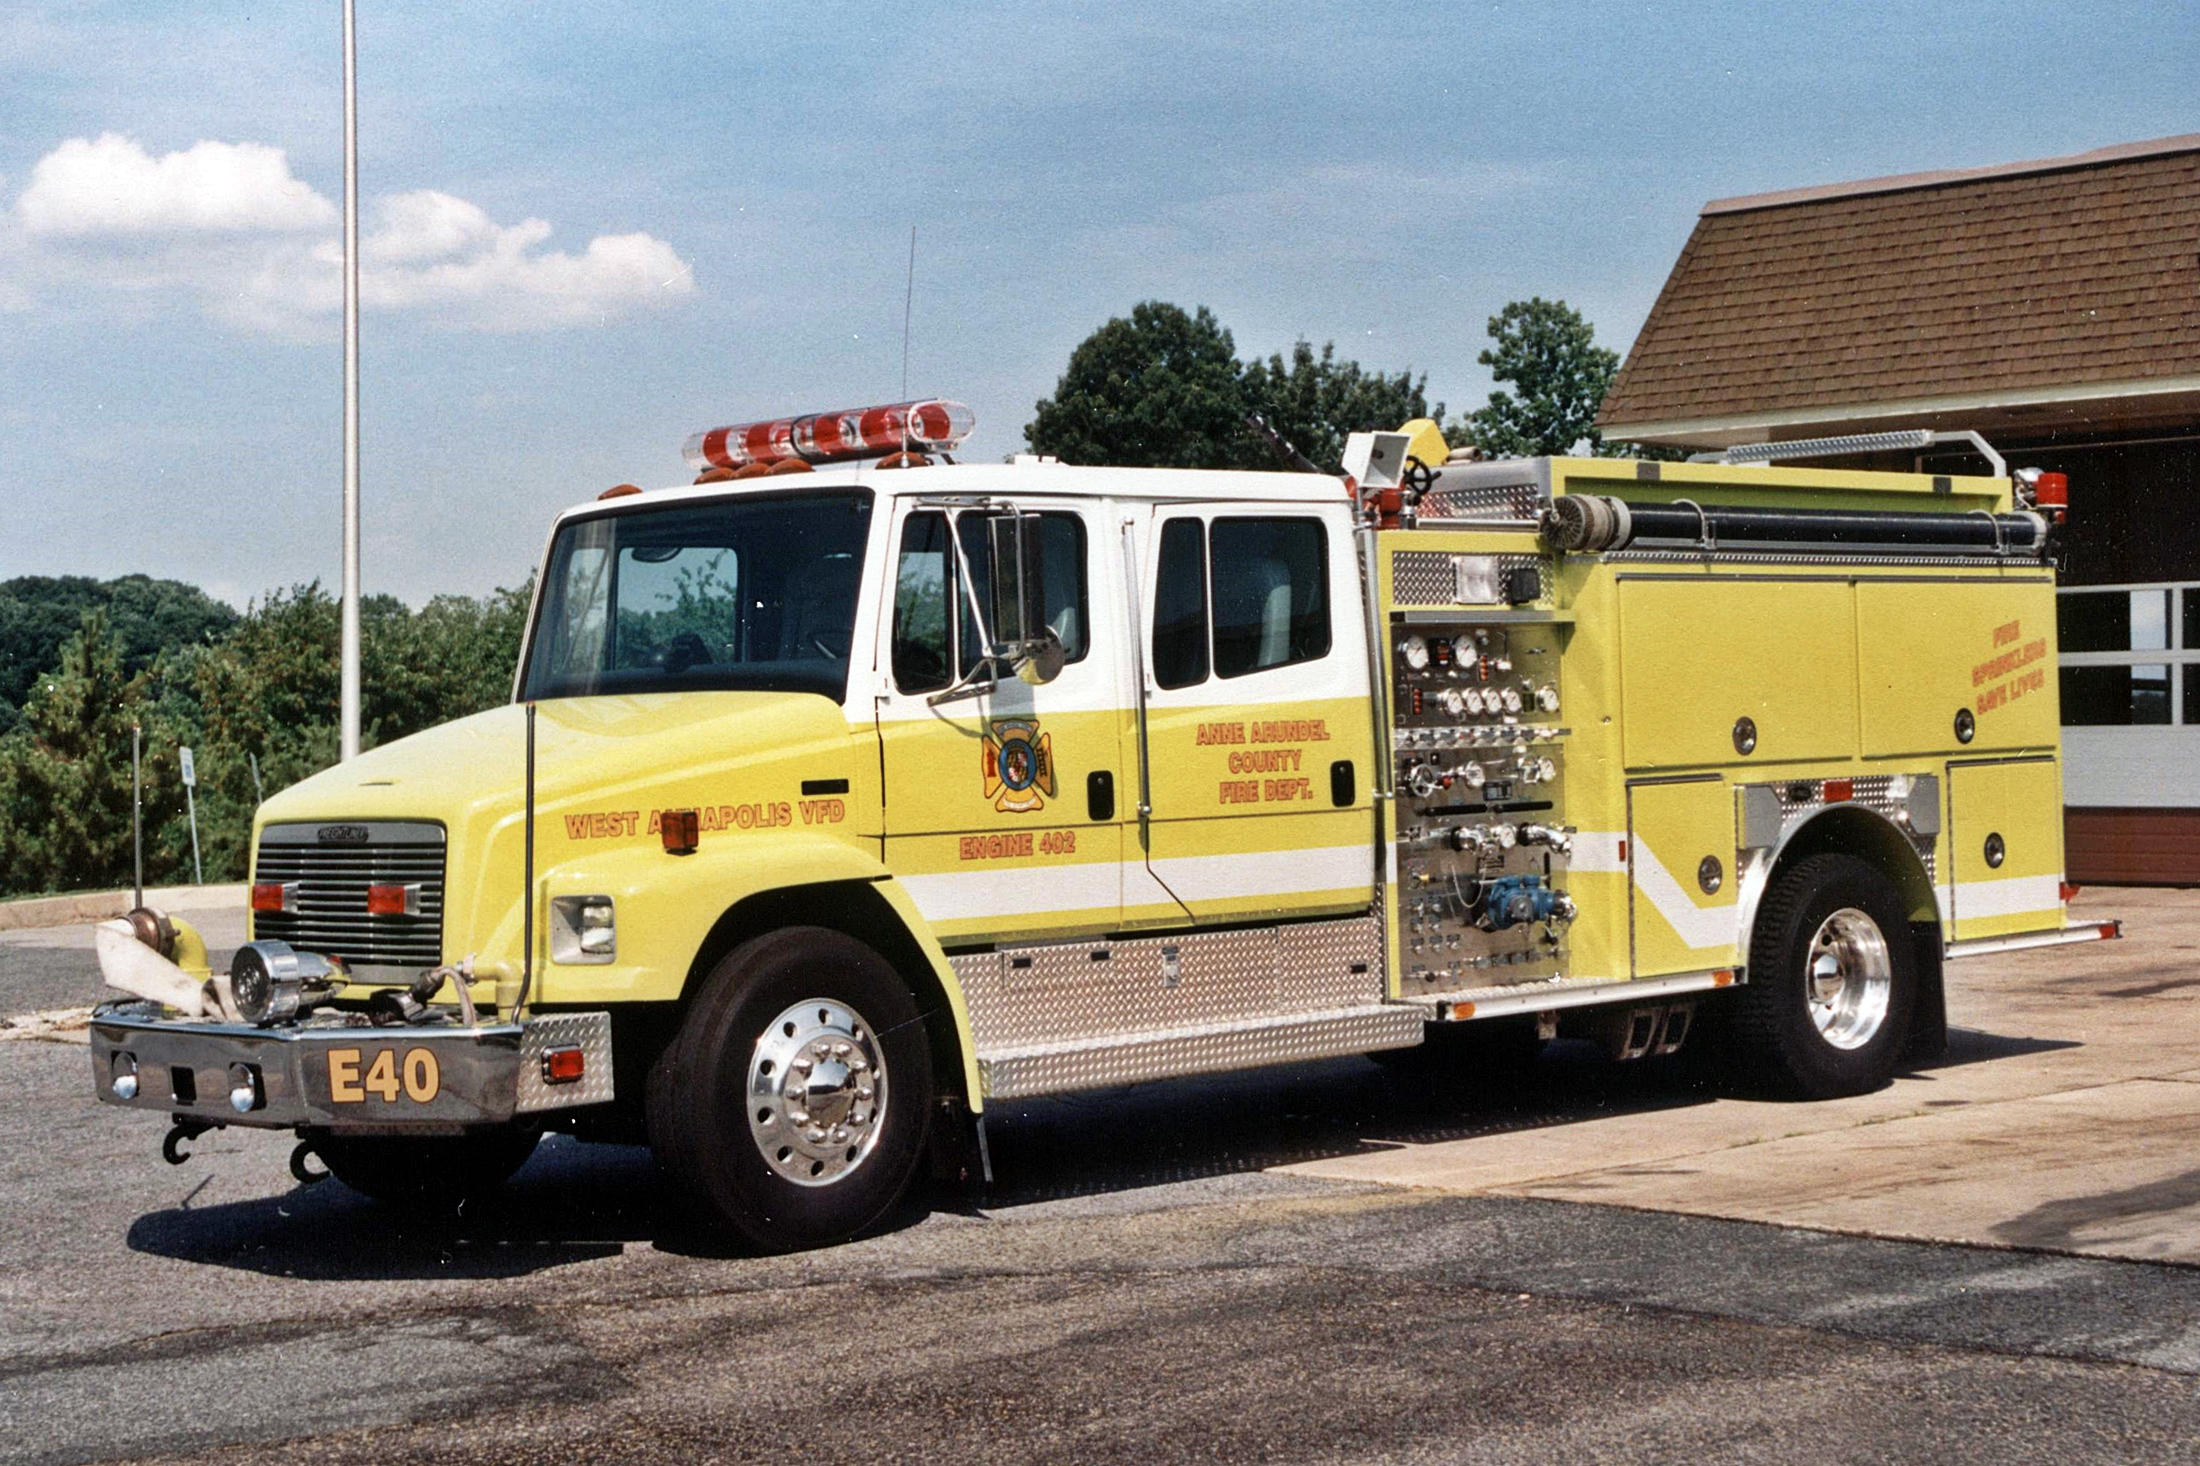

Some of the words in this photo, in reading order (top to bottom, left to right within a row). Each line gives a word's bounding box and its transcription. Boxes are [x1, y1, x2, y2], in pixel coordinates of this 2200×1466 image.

[1196, 723, 1245, 745] ANNE
[1251, 720, 1330, 743] ARUNDEL
[1229, 749, 1302, 773] COUNTY
[1219, 781, 1259, 804] FIRE
[1265, 778, 1313, 801] DEPT.
[565, 811, 639, 840] WEST
[798, 798, 845, 824] VFD
[960, 833, 1033, 860] ENGINE
[1040, 831, 1075, 854] 402
[328, 1047, 440, 1104] E40
